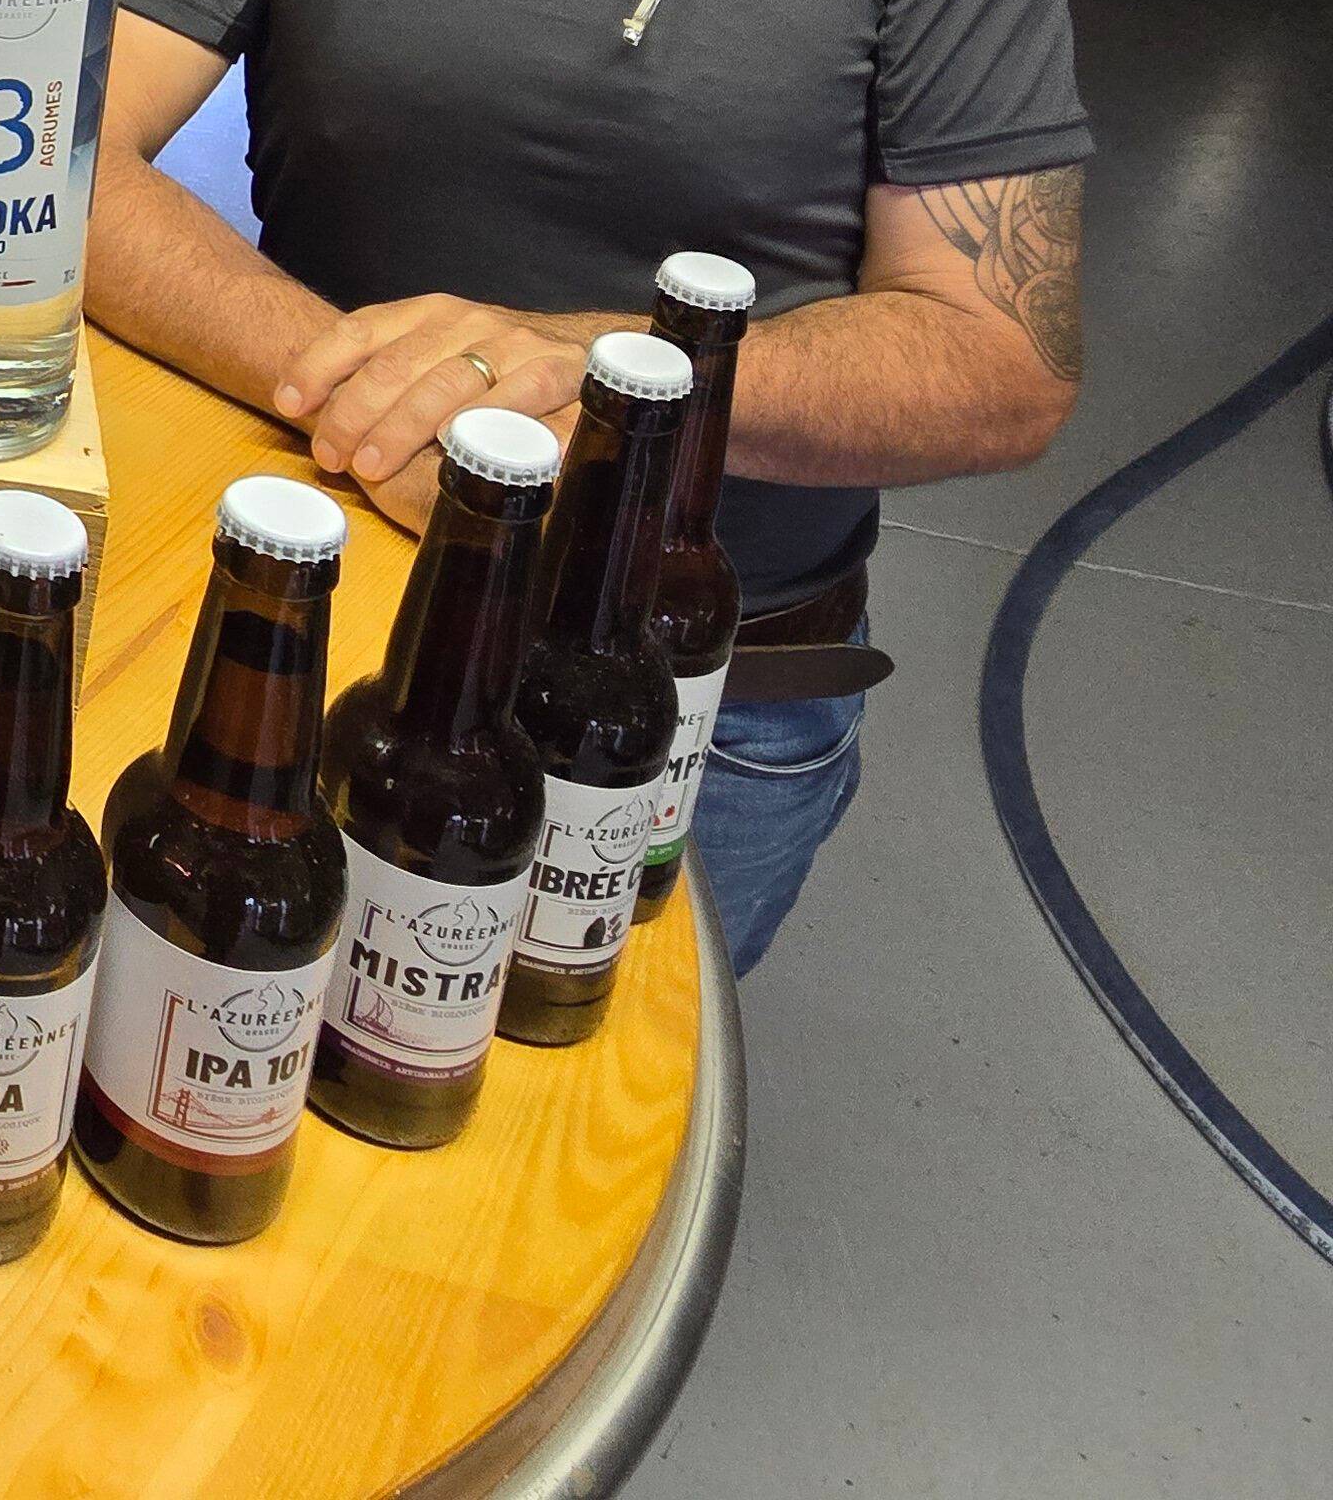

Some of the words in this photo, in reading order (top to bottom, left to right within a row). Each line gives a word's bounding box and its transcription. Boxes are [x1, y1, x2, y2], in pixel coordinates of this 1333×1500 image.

[39, 80, 64, 167] AGRUMES
[349, 938, 505, 1002] MISTRA
[185, 1047, 253, 1089] IPA
[267, 1040, 312, 1086] 101
